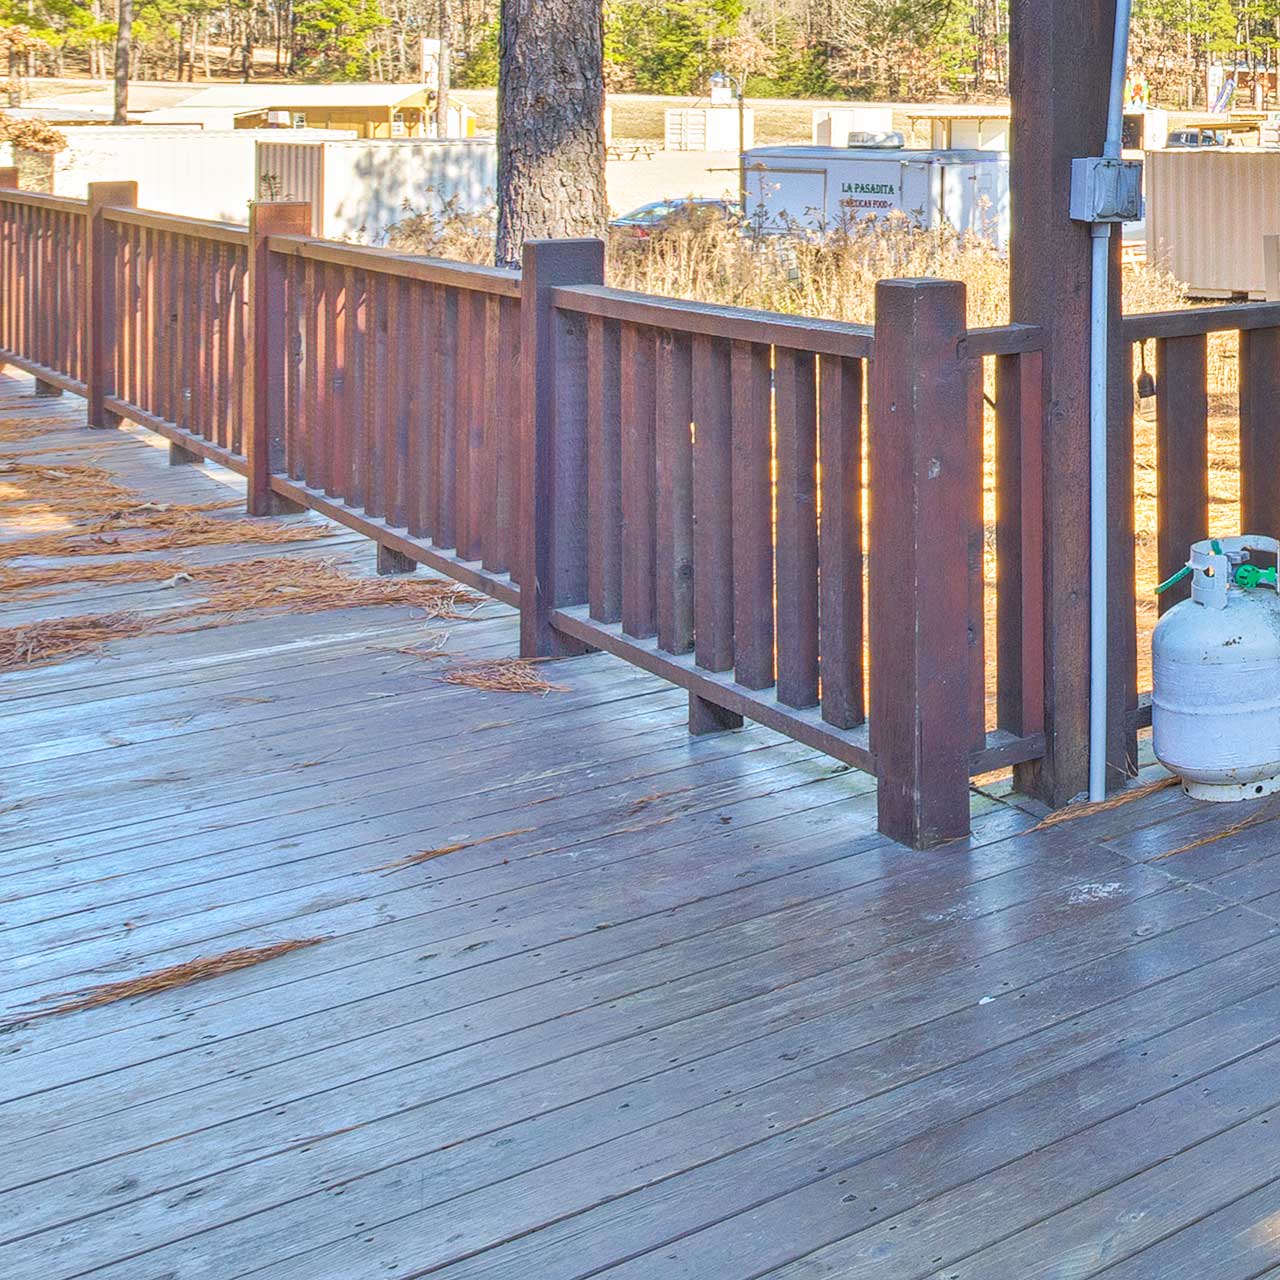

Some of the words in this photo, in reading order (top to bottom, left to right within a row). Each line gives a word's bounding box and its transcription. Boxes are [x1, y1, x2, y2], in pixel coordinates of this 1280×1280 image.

[841, 183, 853, 193] LA
[854, 183, 895, 195] PASADITA
[873, 200, 889, 209] FOOD
